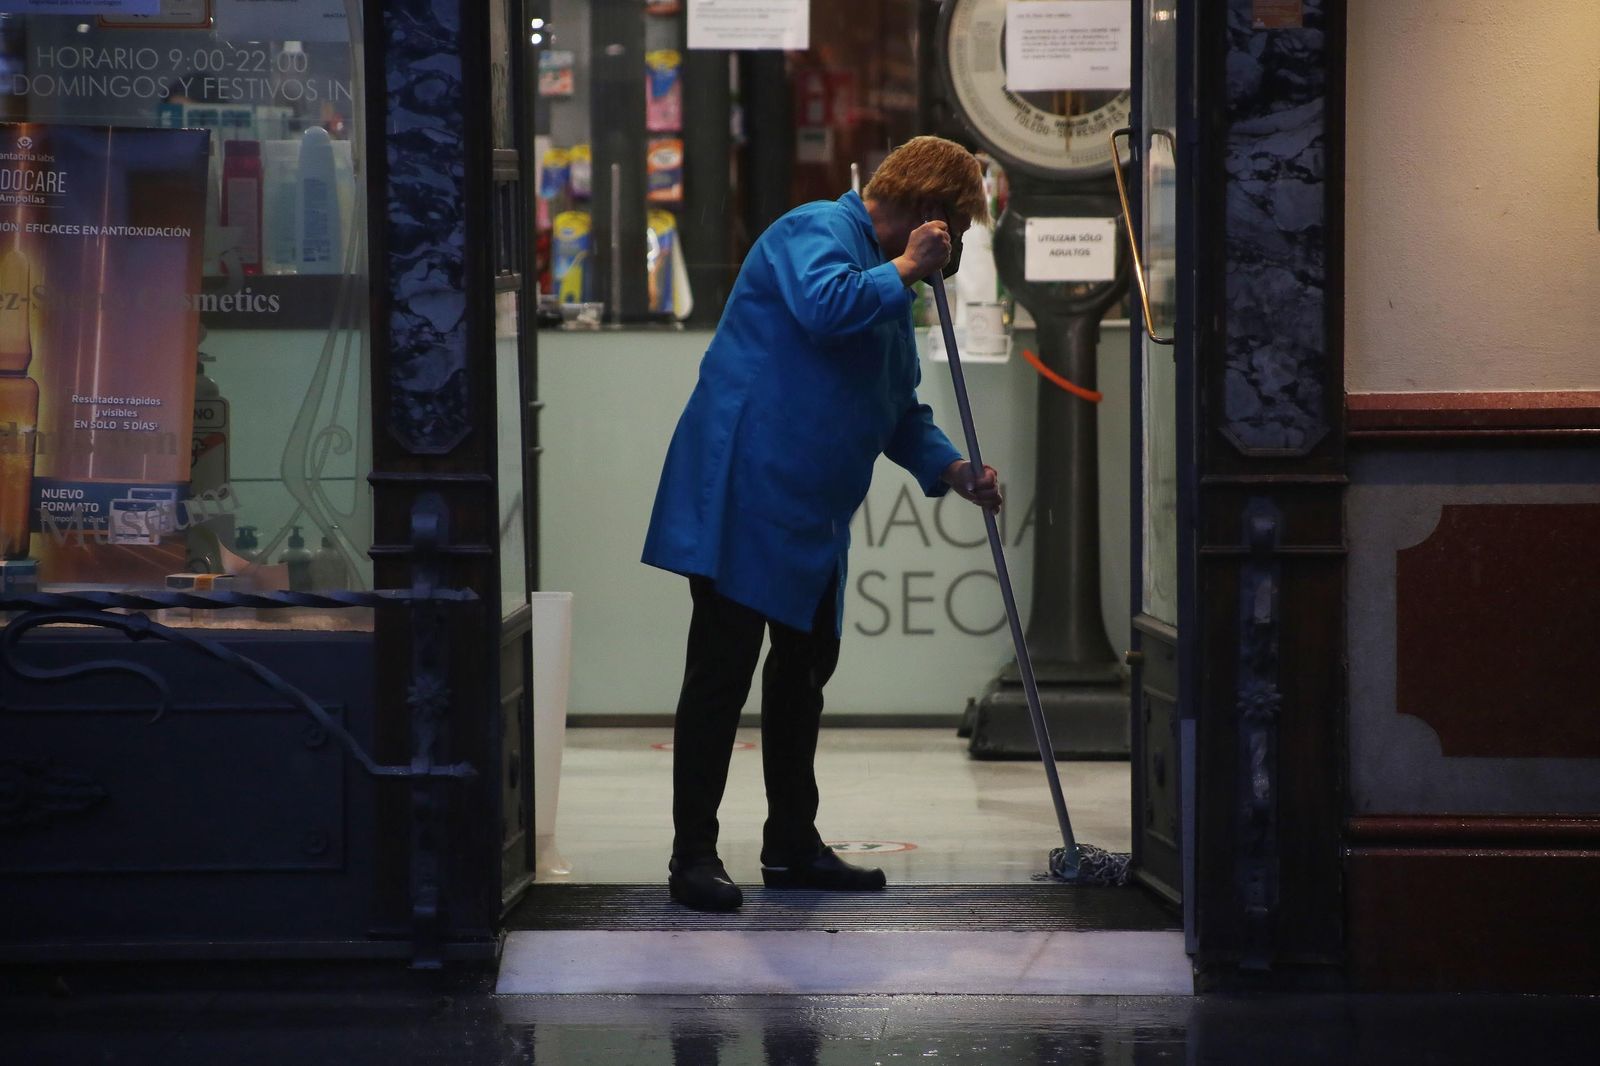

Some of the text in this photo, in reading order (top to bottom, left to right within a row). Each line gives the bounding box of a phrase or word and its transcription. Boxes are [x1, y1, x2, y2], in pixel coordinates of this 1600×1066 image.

[37, 46, 308, 73] HORARIO 9:00-22:00
[12, 74, 170, 98] DOMINGOS
[179, 77, 194, 98] Y
[203, 77, 318, 101] FESTIVOS
[0, 168, 67, 193] DOCARE
[0, 193, 46, 204] Ampollas
[26, 223, 80, 235] EFICACES
[83, 225, 98, 235] EN
[100, 225, 191, 238] ANTIOXIDACIÓN
[71, 394, 124, 404] Resultados
[102, 408, 138, 417] visibles
[74, 420, 88, 429] EN
[123, 421, 130, 430] 5
[41, 488, 84, 500] NUEVO
[40, 501, 99, 513] FORMATO
